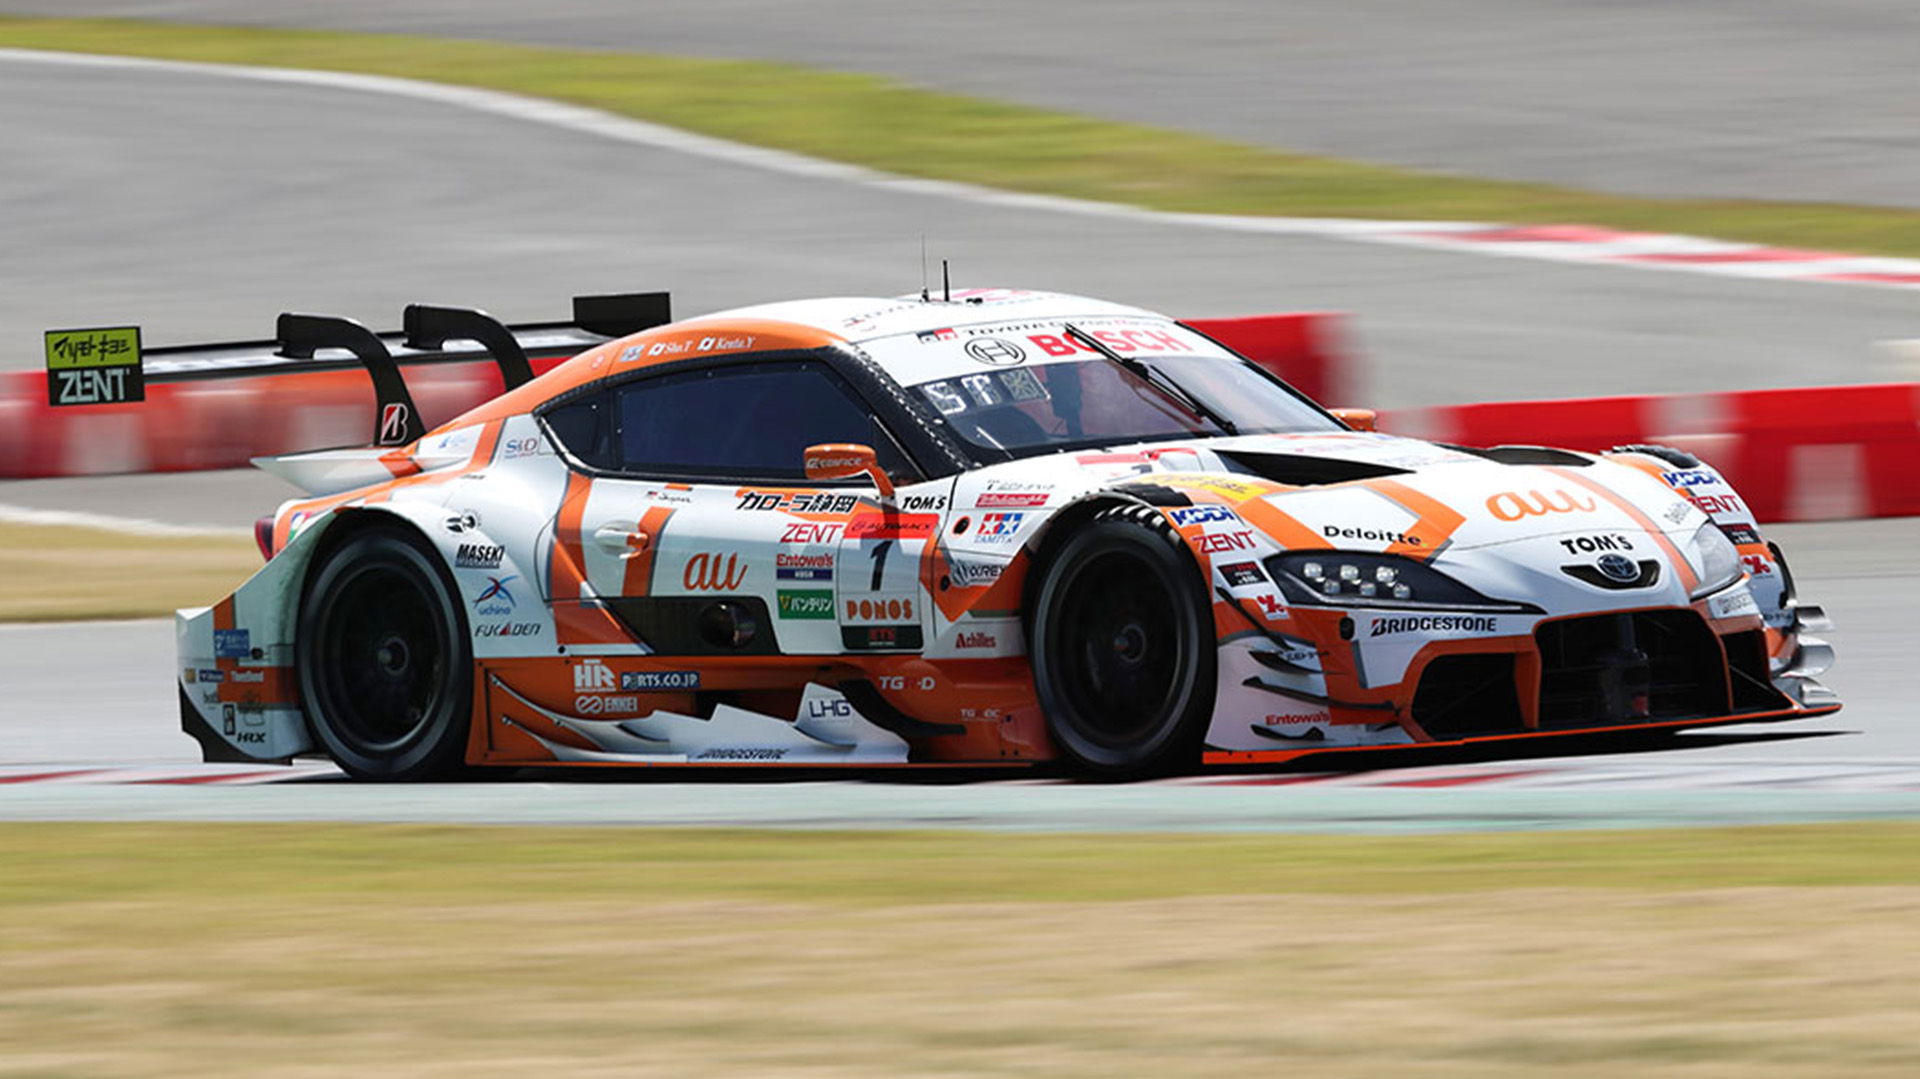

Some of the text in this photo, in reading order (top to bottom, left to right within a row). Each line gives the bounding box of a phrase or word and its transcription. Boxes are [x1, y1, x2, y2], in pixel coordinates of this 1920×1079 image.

[58, 368, 124, 403] ZENT
[735, 492, 859, 513] カローラ静岡
[1486, 489, 1597, 521] au
[1169, 505, 1236, 526] KDDI
[780, 523, 843, 544] ZENT
[1192, 529, 1257, 554] ZENT
[1323, 524, 1422, 545] Deloitte
[1560, 533, 1634, 555] TOM'S
[683, 552, 748, 590] au
[869, 540, 894, 591] 1
[847, 599, 913, 620] PONOS
[1370, 617, 1497, 637] BRIDGESTONE
[808, 699, 851, 718] LHG
